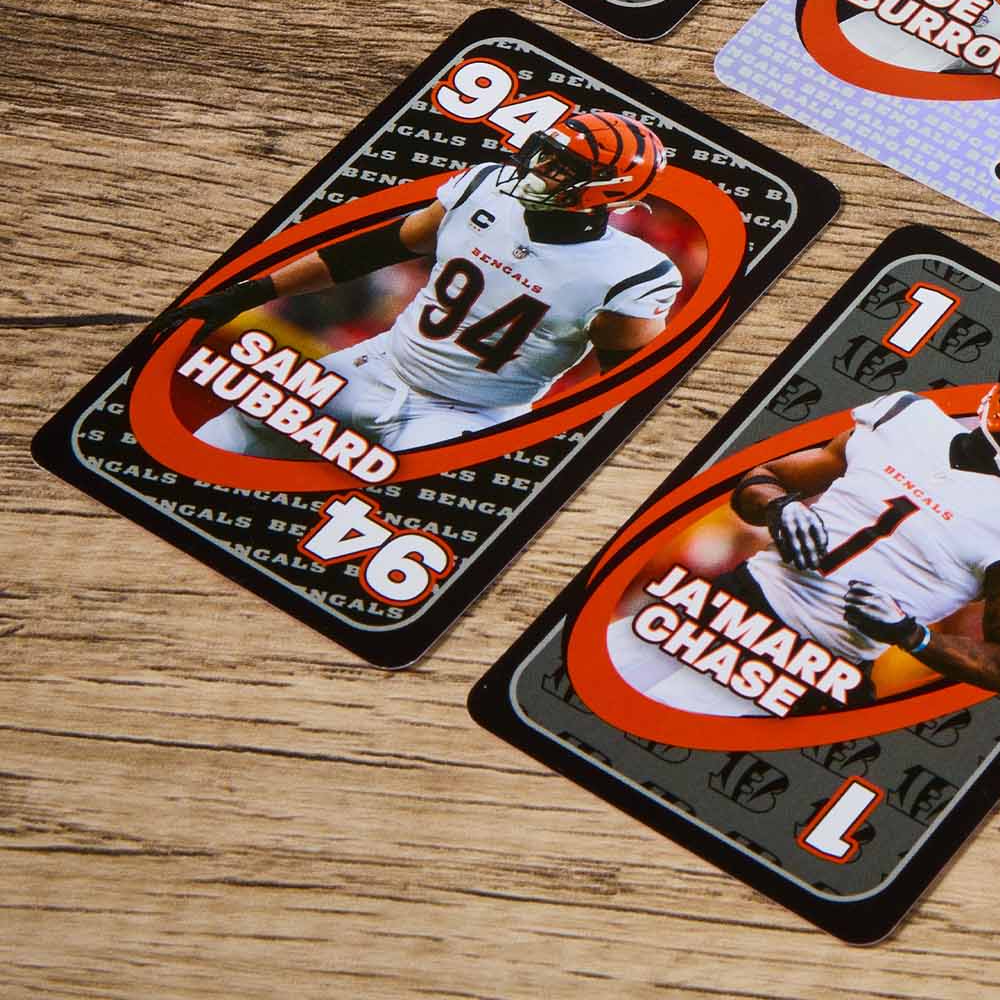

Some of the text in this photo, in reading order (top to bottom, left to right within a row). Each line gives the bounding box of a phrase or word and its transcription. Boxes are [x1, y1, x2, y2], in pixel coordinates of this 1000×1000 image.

[434, 59, 572, 151] 94
[471, 209, 496, 229] C
[418, 257, 552, 374] 94
[471, 247, 544, 294] BENGALS
[883, 281, 961, 357] 1
[177, 345, 399, 484] HUBBARD
[230, 330, 348, 410] SAM
[820, 493, 919, 576] 1
[882, 464, 955, 522] BENGALS
[300, 491, 452, 603] 94
[631, 603, 806, 719] CHASE
[645, 566, 863, 705] JA'MARR
[800, 775, 884, 865] 1
